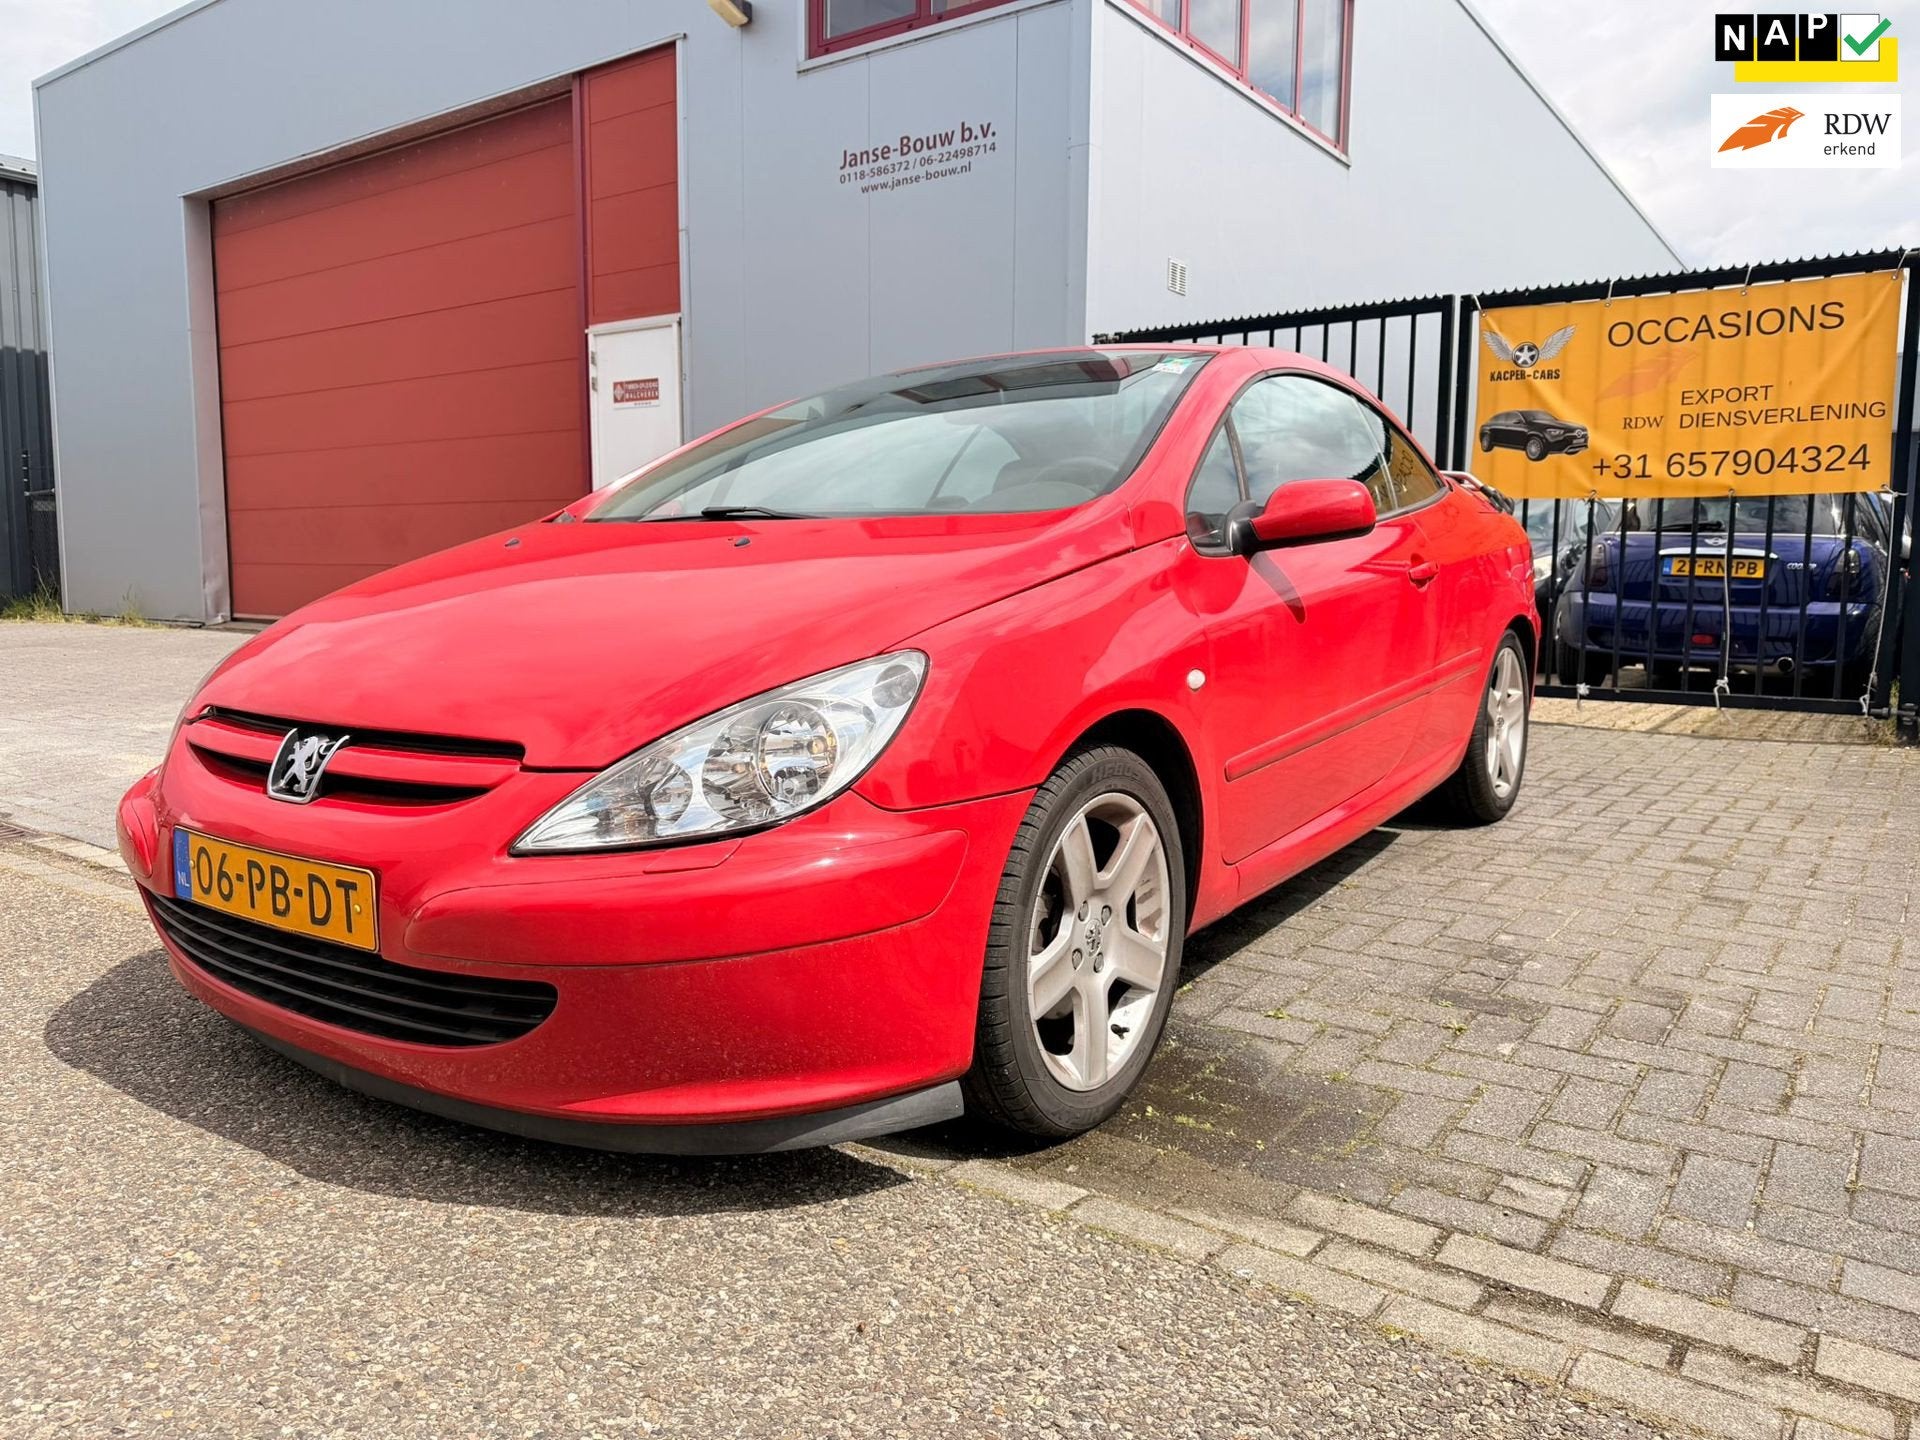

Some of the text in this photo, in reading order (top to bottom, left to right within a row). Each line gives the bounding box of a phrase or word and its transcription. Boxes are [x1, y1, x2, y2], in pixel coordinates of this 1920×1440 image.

[840, 121, 997, 170] Janse-Bouw b.v.
[839, 161, 910, 184] 0118-586372
[919, 142, 997, 167] 06-22498714
[861, 161, 972, 194] www.janse-bouw.nl
[1608, 302, 1845, 347] OCCASIONS
[1490, 368, 1560, 382] KACPER-CARS
[1680, 384, 1774, 406] EXPORT
[1622, 401, 1887, 430] RDW DIENSVERLENING
[1592, 443, 1871, 479] +31 657904324
[177, 871, 190, 888] NL
[196, 846, 358, 934] 06-PB-DT
